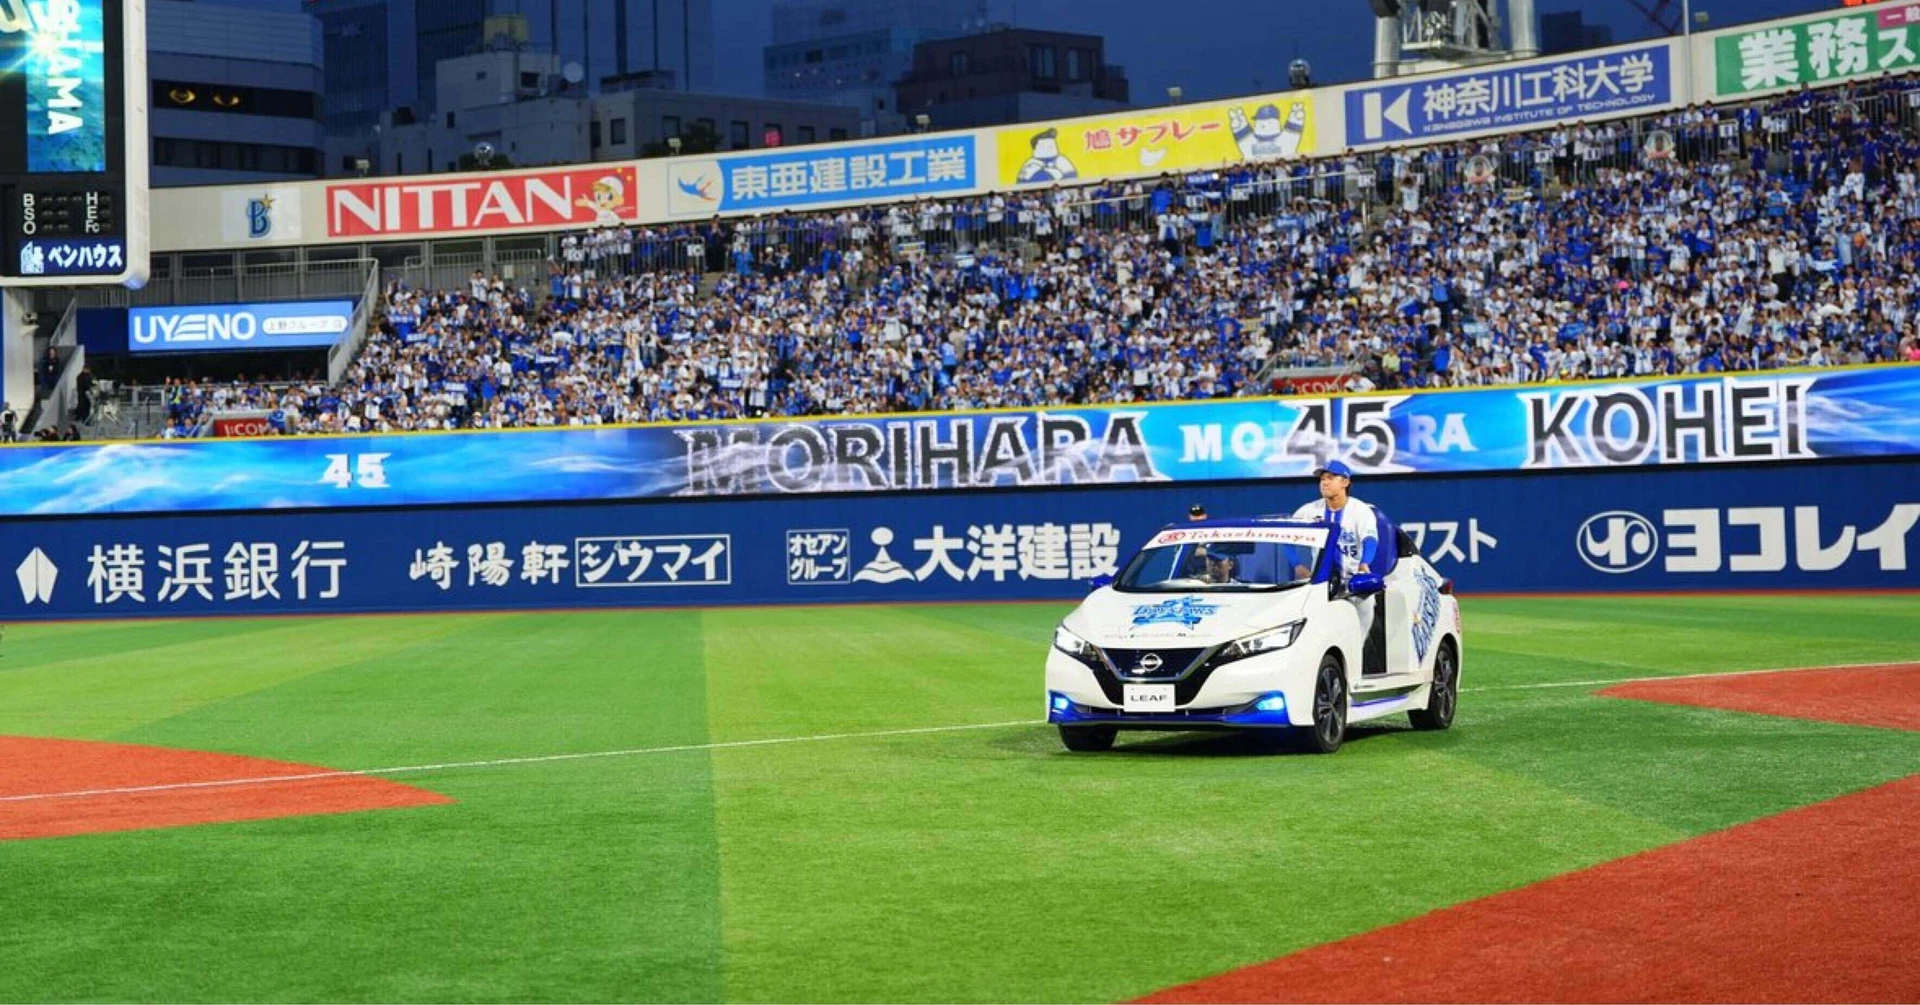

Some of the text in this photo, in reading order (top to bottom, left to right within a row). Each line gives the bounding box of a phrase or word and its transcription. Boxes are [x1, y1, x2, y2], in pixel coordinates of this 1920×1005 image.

[1423, 53, 1654, 121] 神奈川工科大学
[1494, 107, 1553, 122] INSTITUTE
[1557, 105, 1573, 114] OF
[1578, 93, 1655, 111] TECHNOLOGY
[731, 146, 966, 200] 東亜建設工業
[332, 175, 572, 234] NITTAN
[134, 311, 256, 344] UYENO
[1264, 394, 1417, 476] 45
[1516, 376, 1821, 469] KOHEI
[322, 453, 392, 489] 45
[671, 410, 1172, 495] MORIHARA
[790, 533, 847, 556] オセアン
[913, 522, 1120, 582] 大洋建設
[1189, 529, 1317, 543] Takashimaya
[1337, 544, 1359, 560] 45
[1663, 503, 1920, 572] ヨコレイ
[87, 540, 347, 604] 横浜銀行
[409, 540, 725, 590] 崎陽軒 シウマイ
[790, 557, 848, 580] グループ
[1130, 694, 1168, 703] LEAF
